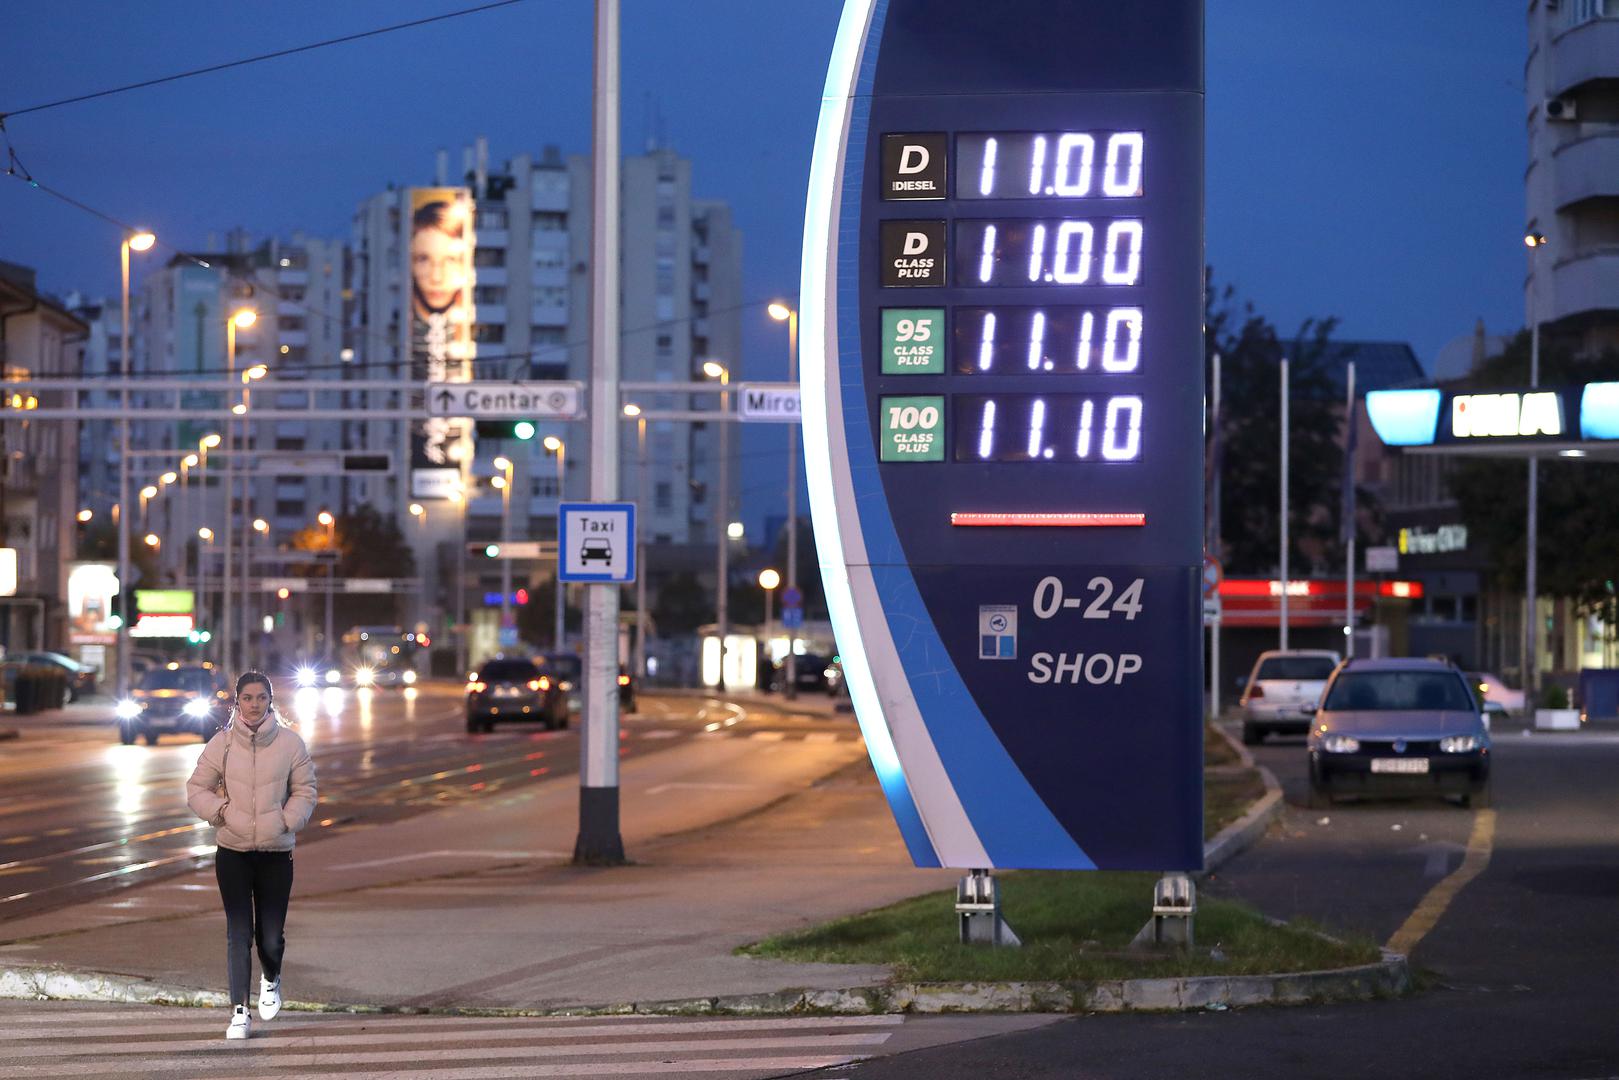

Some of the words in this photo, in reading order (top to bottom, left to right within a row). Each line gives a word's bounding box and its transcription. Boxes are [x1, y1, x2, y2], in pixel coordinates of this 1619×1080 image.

[898, 145, 930, 174] D
[895, 180, 937, 191] DIESEL
[903, 232, 929, 255] D
[894, 258, 935, 268] CLASS
[897, 268, 930, 278] PLUS
[895, 319, 932, 342] 95
[893, 345, 934, 356] CLASS
[897, 355, 930, 366] PLUS
[464, 389, 540, 410] Centar
[748, 392, 801, 412] Miro
[889, 406, 939, 429] 100
[893, 433, 934, 443] CLASS
[897, 443, 930, 453] PLUS
[580, 517, 614, 532] Taxi
[1032, 576, 1145, 620] 0-24
[1027, 652, 1143, 685] SHOP
